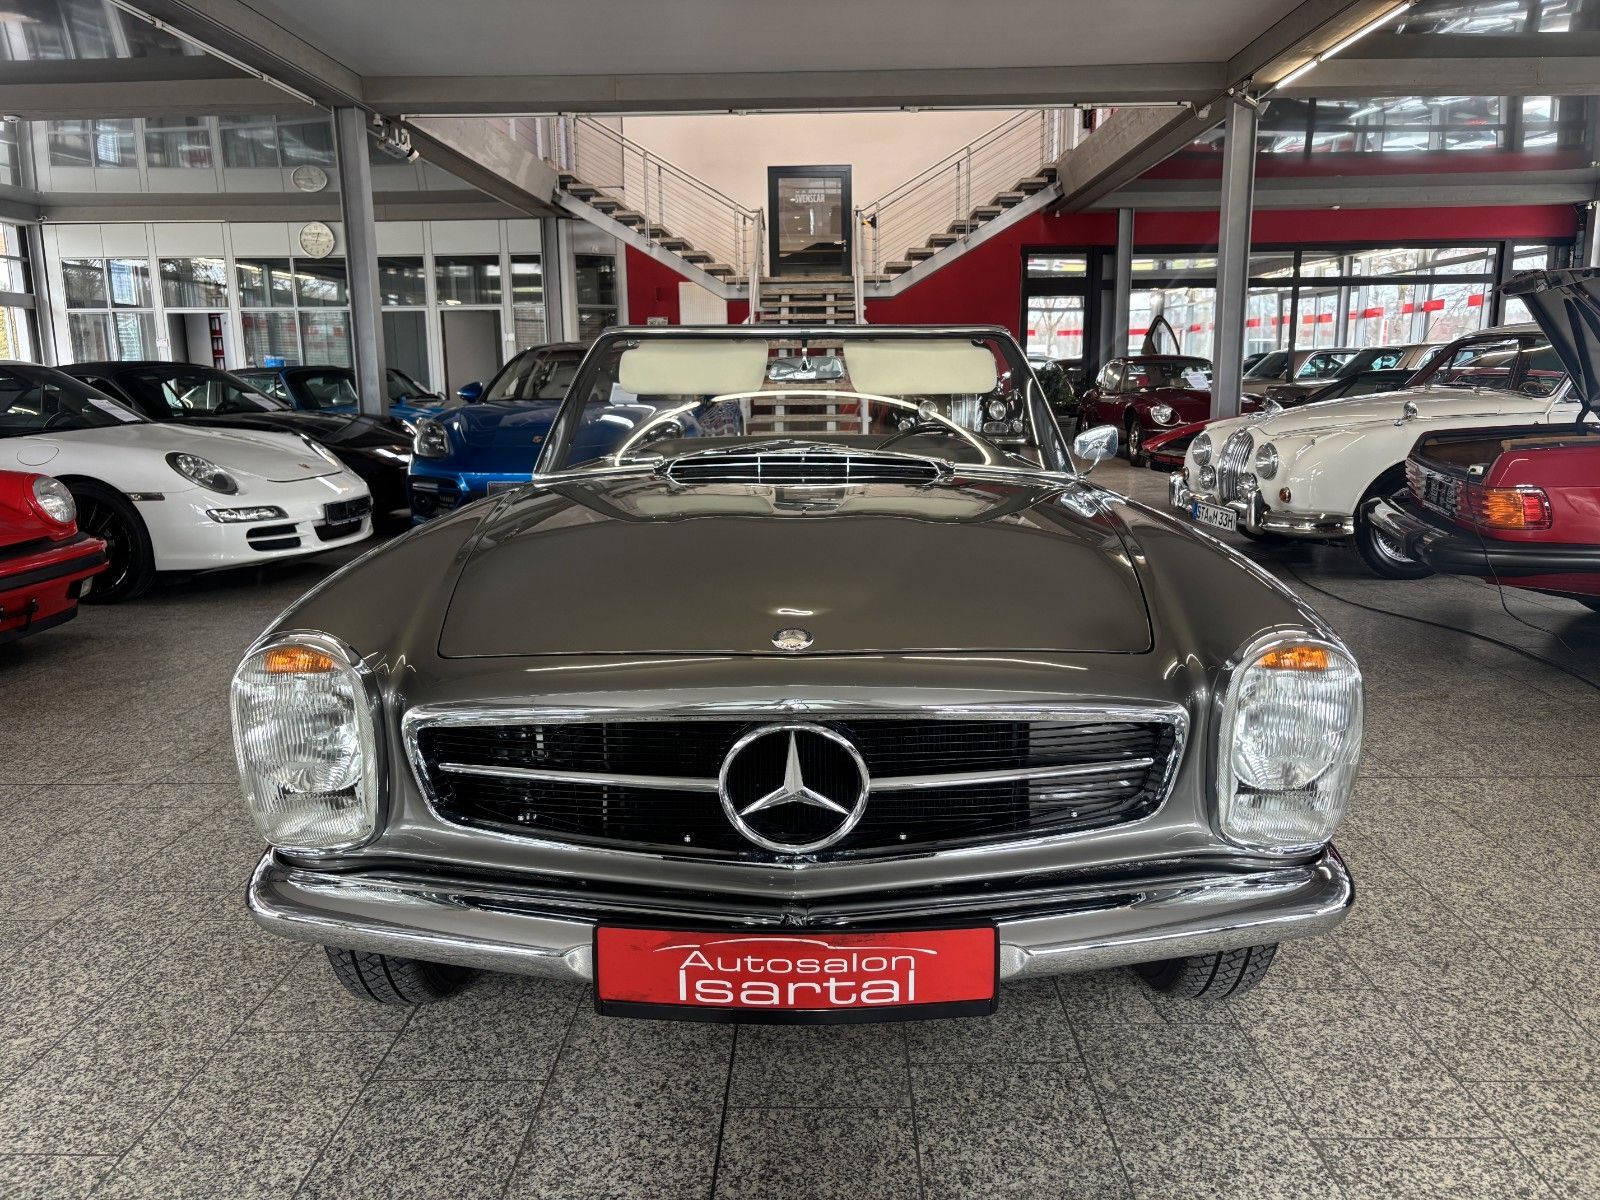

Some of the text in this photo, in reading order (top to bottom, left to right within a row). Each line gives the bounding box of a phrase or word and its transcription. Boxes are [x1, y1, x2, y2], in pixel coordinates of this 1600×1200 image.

[1196, 505, 1209, 521] STA
[1218, 512, 1233, 529] 33H
[679, 950, 915, 973] Autosalon
[679, 969, 915, 1005] Isartal
